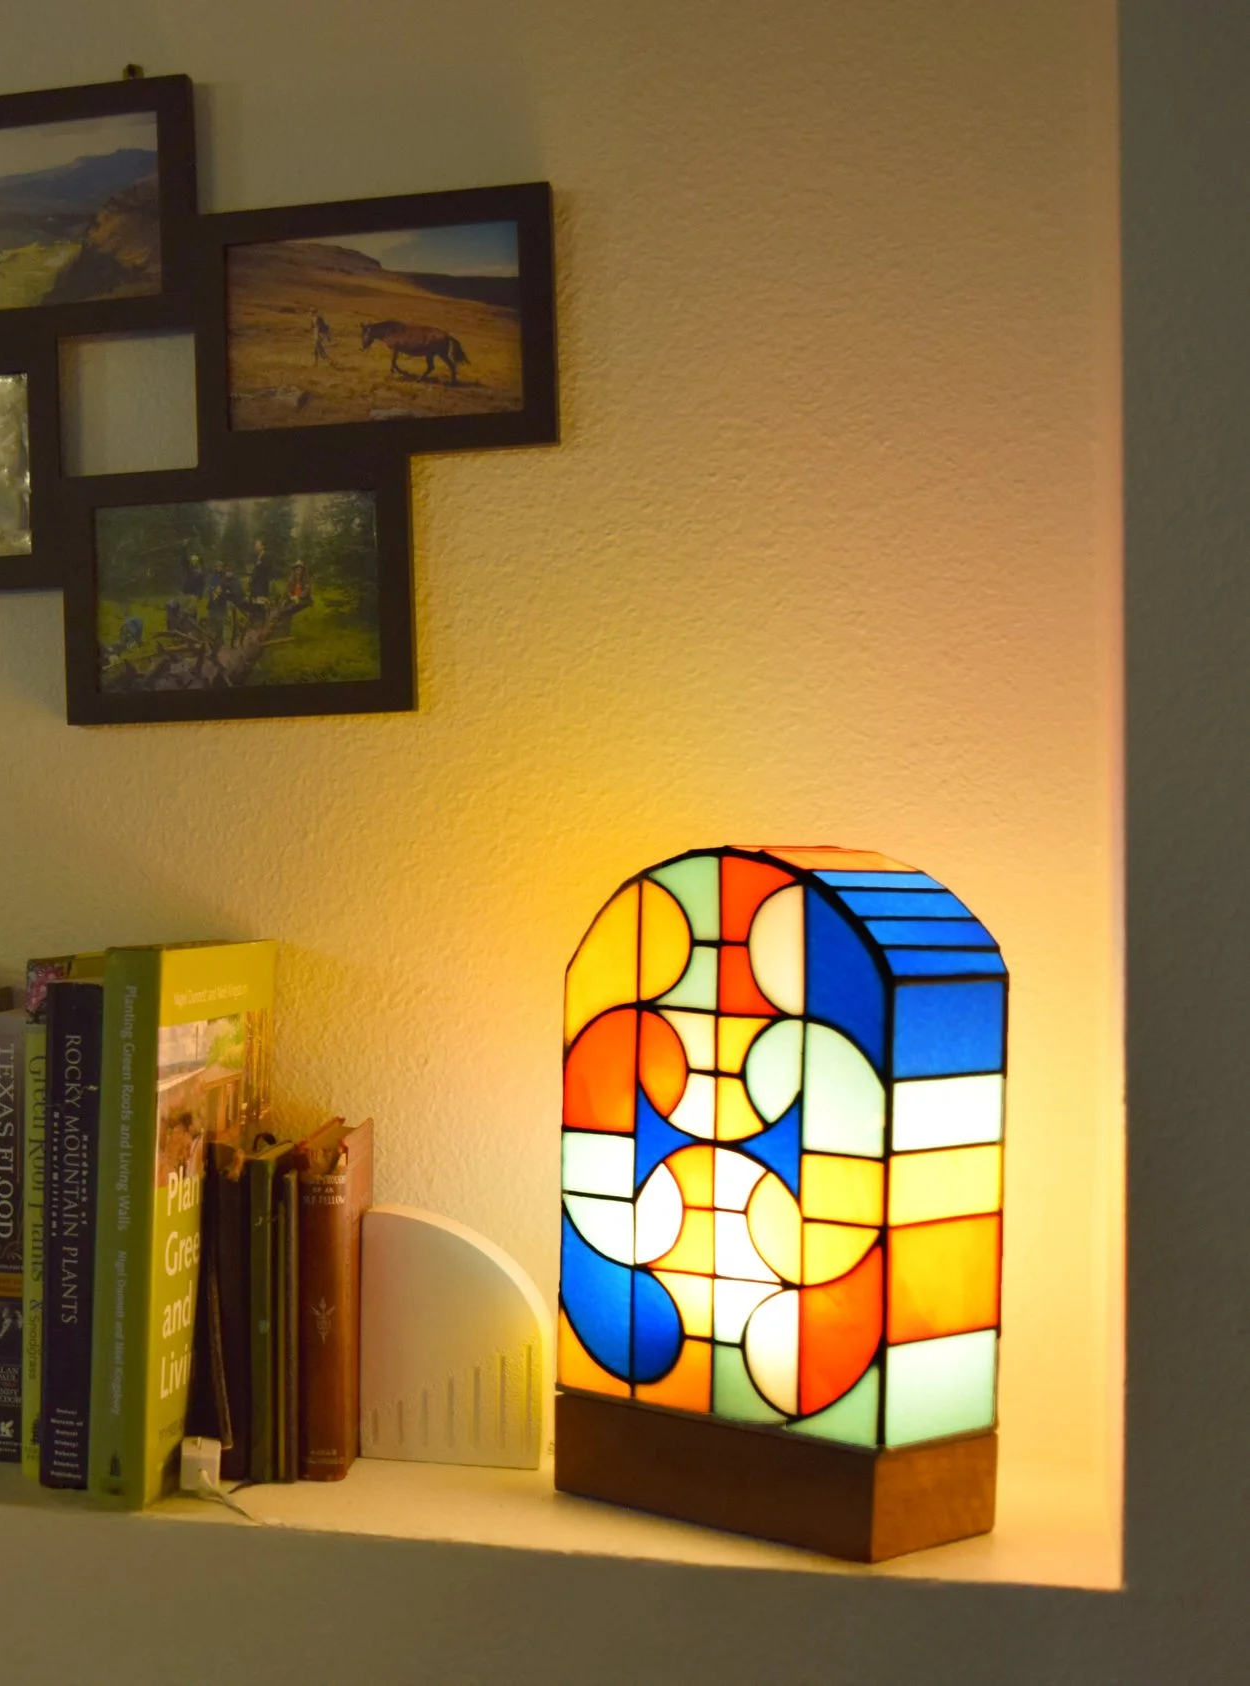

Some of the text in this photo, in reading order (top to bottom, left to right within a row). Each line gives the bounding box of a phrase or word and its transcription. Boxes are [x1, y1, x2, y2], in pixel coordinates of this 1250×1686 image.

[116, 985, 138, 1231] Planting Green Roofs and Living Walls
[61, 1034, 83, 1324] ROCKY MOUNTAIN PLANTS
[114, 1250, 128, 1276] Nigel
[164, 1230, 201, 1277] Gree
[114, 1321, 126, 1340] and
[161, 1280, 193, 1339] and
[26, 1315, 41, 1381] Snodgrass
[110, 1367, 125, 1416] Kingsbury
